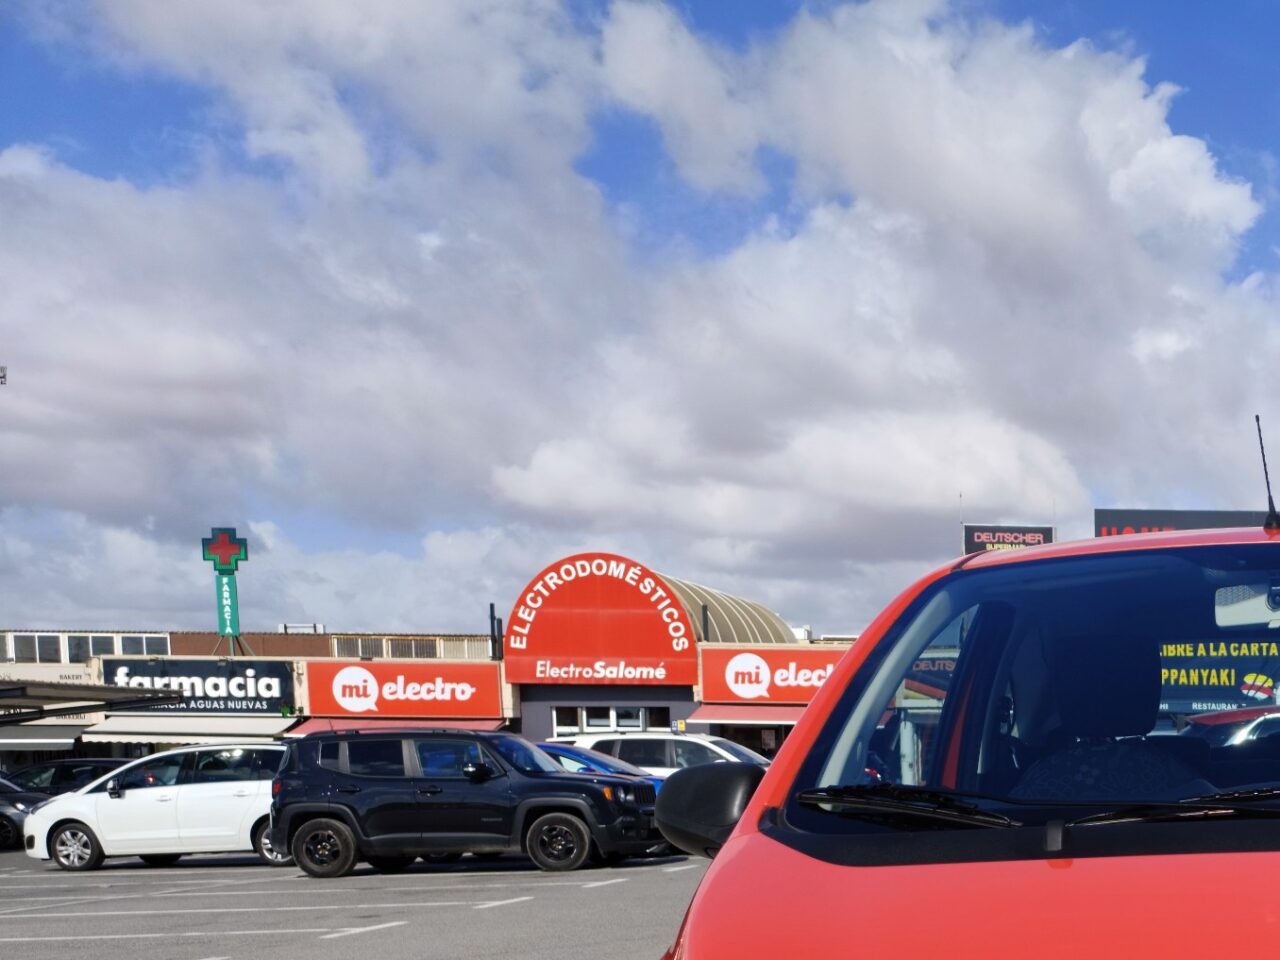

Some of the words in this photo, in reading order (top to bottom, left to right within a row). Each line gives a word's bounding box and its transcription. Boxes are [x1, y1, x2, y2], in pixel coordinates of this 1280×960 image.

[974, 532, 1044, 545] DEUTSCHER
[222, 577, 233, 633] FARMACIA
[510, 559, 689, 651] ELECTRODOMÉSTICOS
[1160, 643, 1194, 657] IBRE
[1197, 642, 1206, 657] A
[1209, 642, 1228, 657] LA
[1230, 642, 1279, 657] CARTA
[535, 660, 667, 680] ElectroSalomé
[734, 665, 763, 685] mi
[1161, 668, 1236, 686] PPANYAKI
[114, 666, 281, 698] farmacia
[341, 679, 372, 698] mi
[381, 675, 476, 701] electro
[190, 700, 225, 709] AGUAS
[228, 701, 268, 709] NUEVAS
